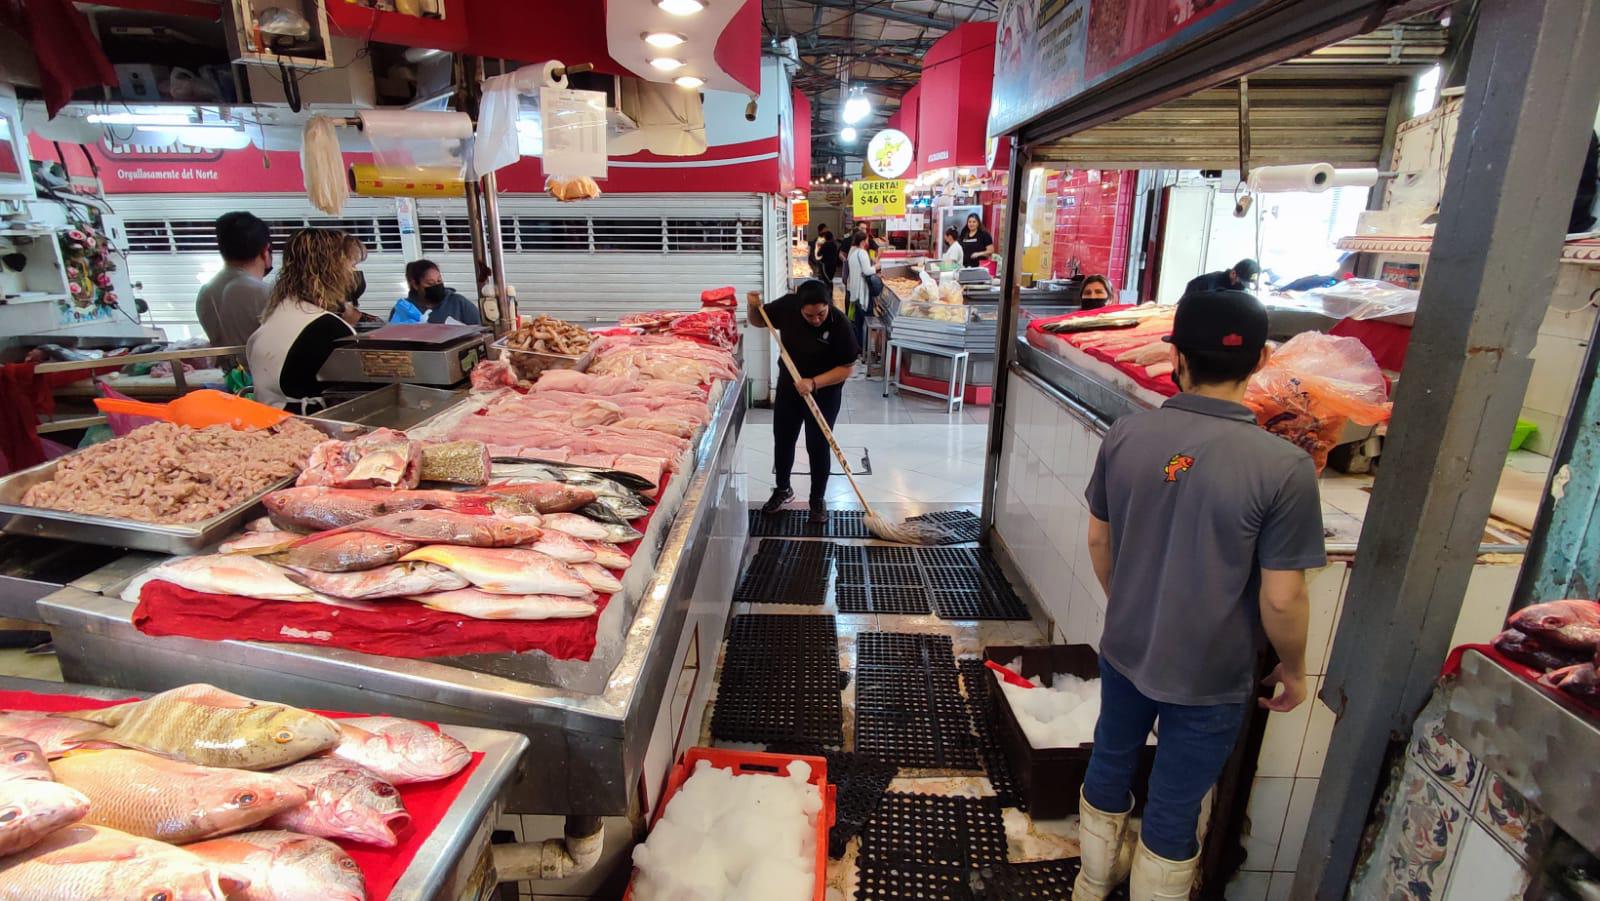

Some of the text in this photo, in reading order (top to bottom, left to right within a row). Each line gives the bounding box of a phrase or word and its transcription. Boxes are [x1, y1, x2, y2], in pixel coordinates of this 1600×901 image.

[117, 168, 218, 180] Orgullosamente del Norte
[882, 194, 898, 204] KG
